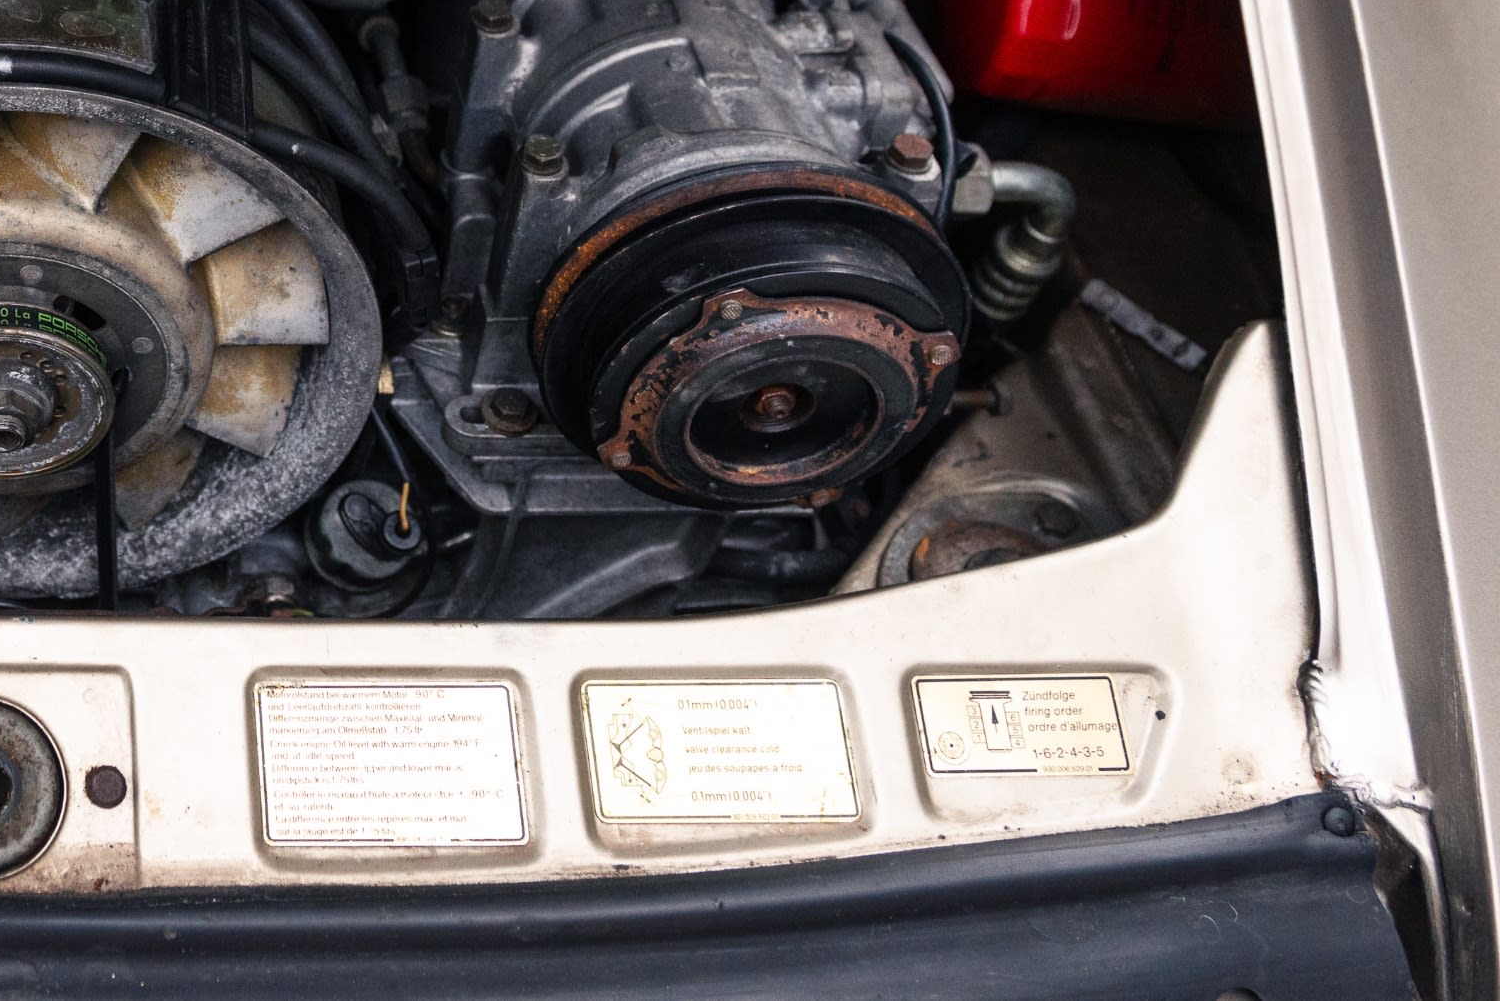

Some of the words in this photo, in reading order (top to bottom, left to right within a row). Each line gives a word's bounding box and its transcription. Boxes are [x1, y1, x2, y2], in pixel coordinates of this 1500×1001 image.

[15, 308, 31, 319] La
[1025, 706, 1050, 718] firing
[1053, 707, 1083, 716] order
[973, 721, 979, 729] 2
[1028, 722, 1057, 732] ordre
[1060, 721, 1118, 733] d'allumage
[684, 745, 709, 754] valve
[711, 744, 757, 754] clearance
[759, 744, 780, 754] cold
[1032, 746, 1105, 759] 1-6-2-4-3-5
[704, 764, 722, 773] des
[723, 764, 770, 775] soupapes
